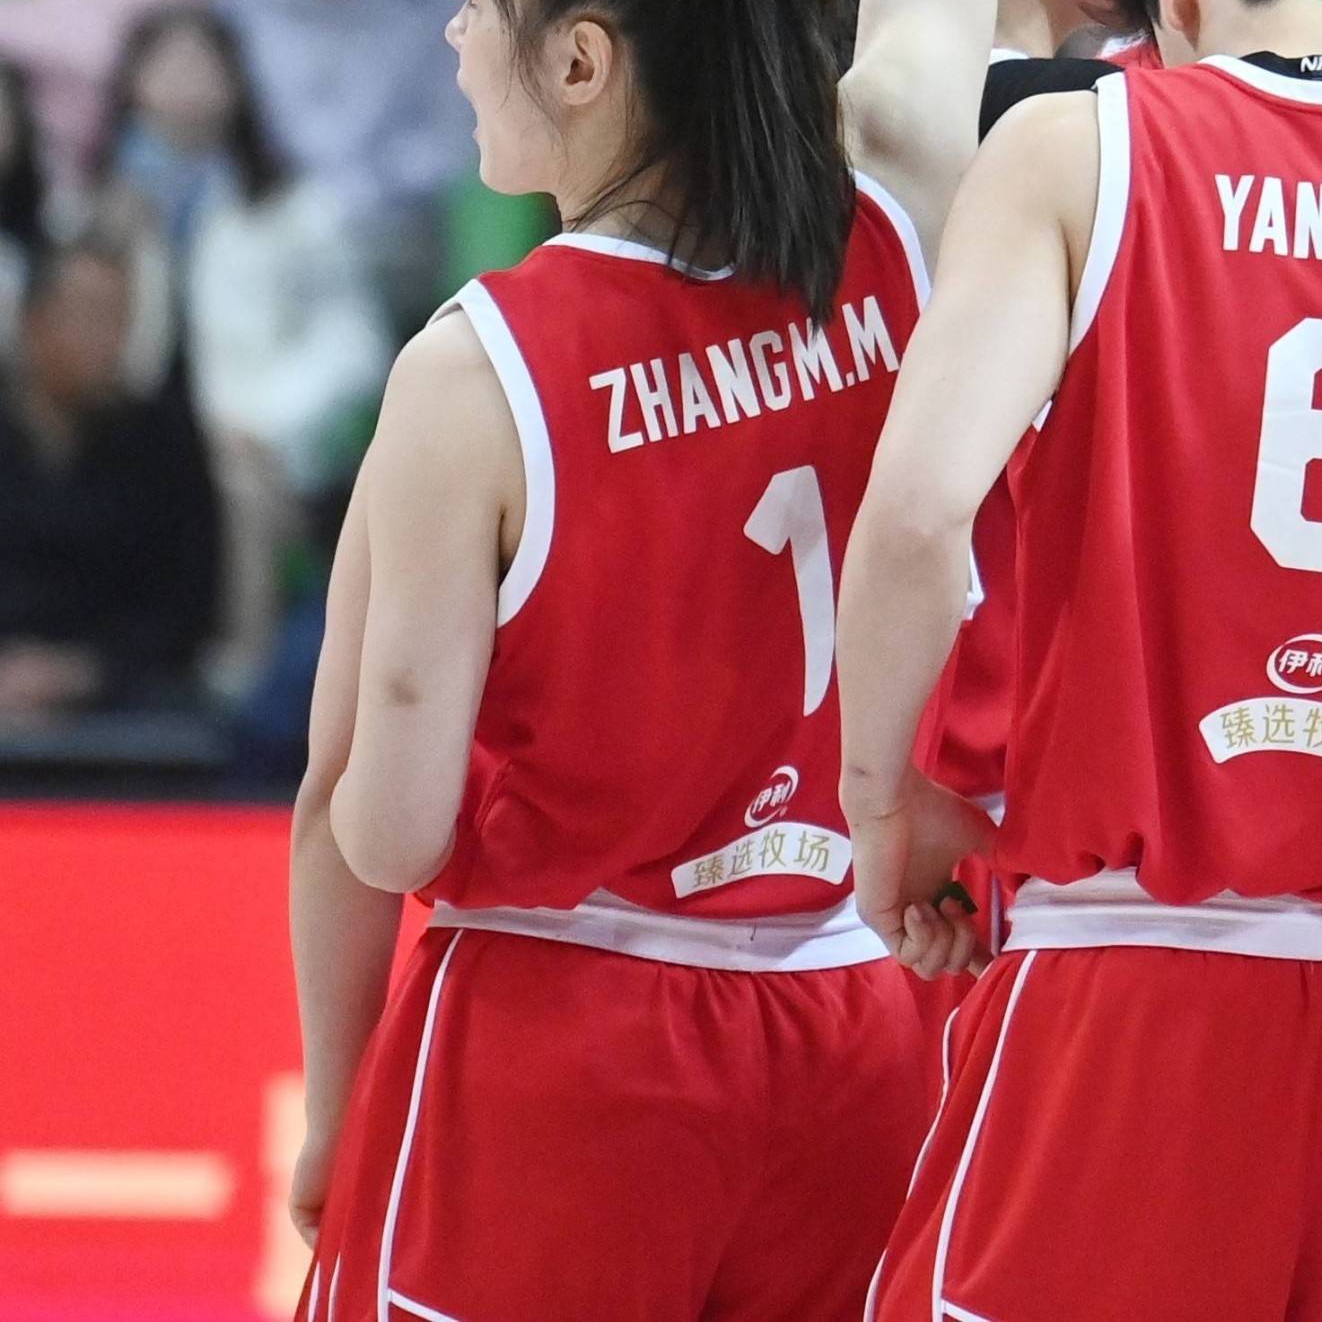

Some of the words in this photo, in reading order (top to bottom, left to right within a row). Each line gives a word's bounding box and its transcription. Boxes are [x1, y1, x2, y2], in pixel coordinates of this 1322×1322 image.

[742, 465, 835, 717] 1
[751, 780, 791, 814] 伊利
[692, 828, 831, 889] 臻选牧场
